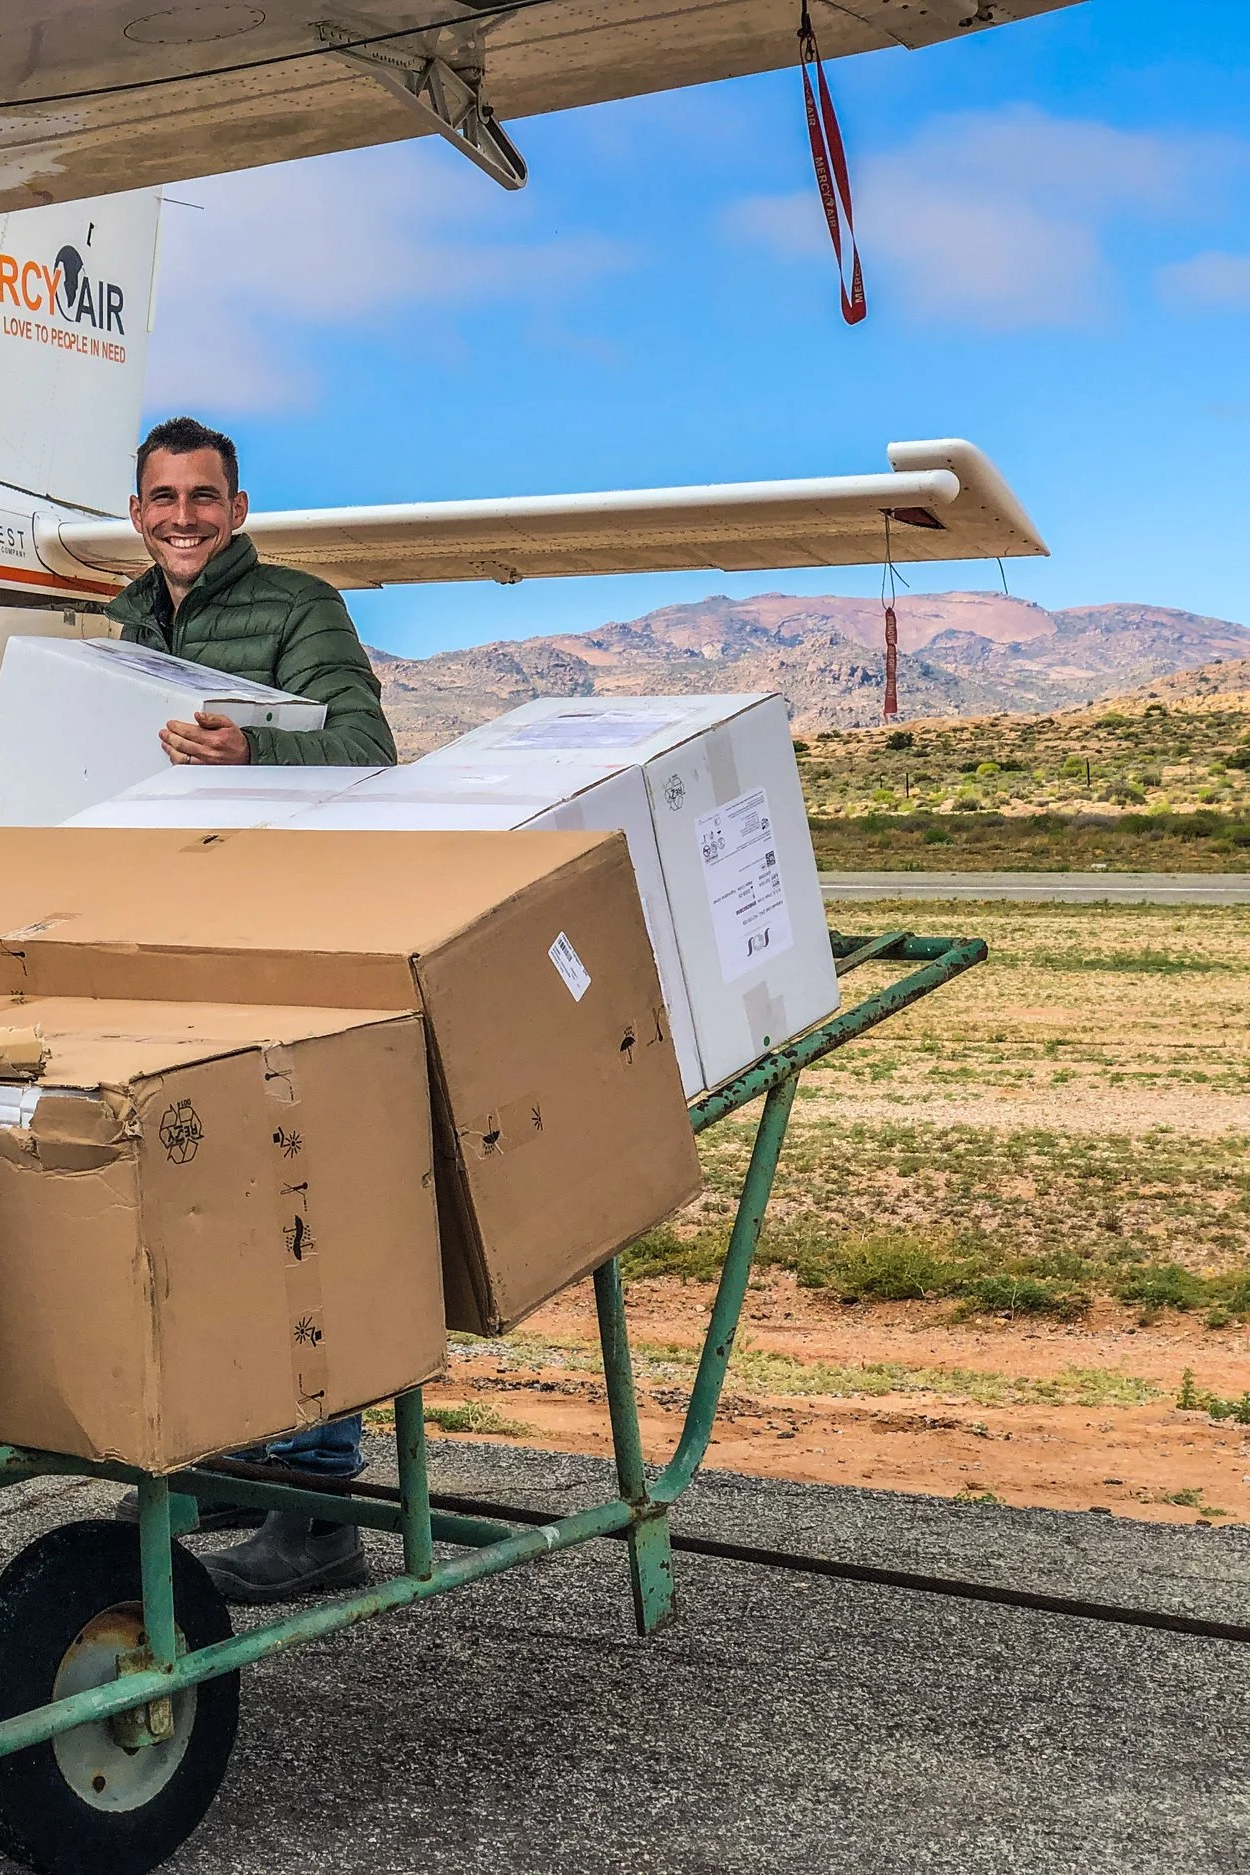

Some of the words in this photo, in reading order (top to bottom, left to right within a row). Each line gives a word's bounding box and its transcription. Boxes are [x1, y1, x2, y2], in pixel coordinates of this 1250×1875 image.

[806, 106, 816, 126] AIR
[815, 156, 832, 198] MERCY
[826, 209, 838, 228] AIR
[76, 276, 125, 336] AIR
[3, 316, 32, 340] LOVE
[35, 323, 49, 345] TO
[51, 328, 88, 355] PEOPLE
[90, 337, 100, 358] IN
[102, 339, 126, 364] NEED
